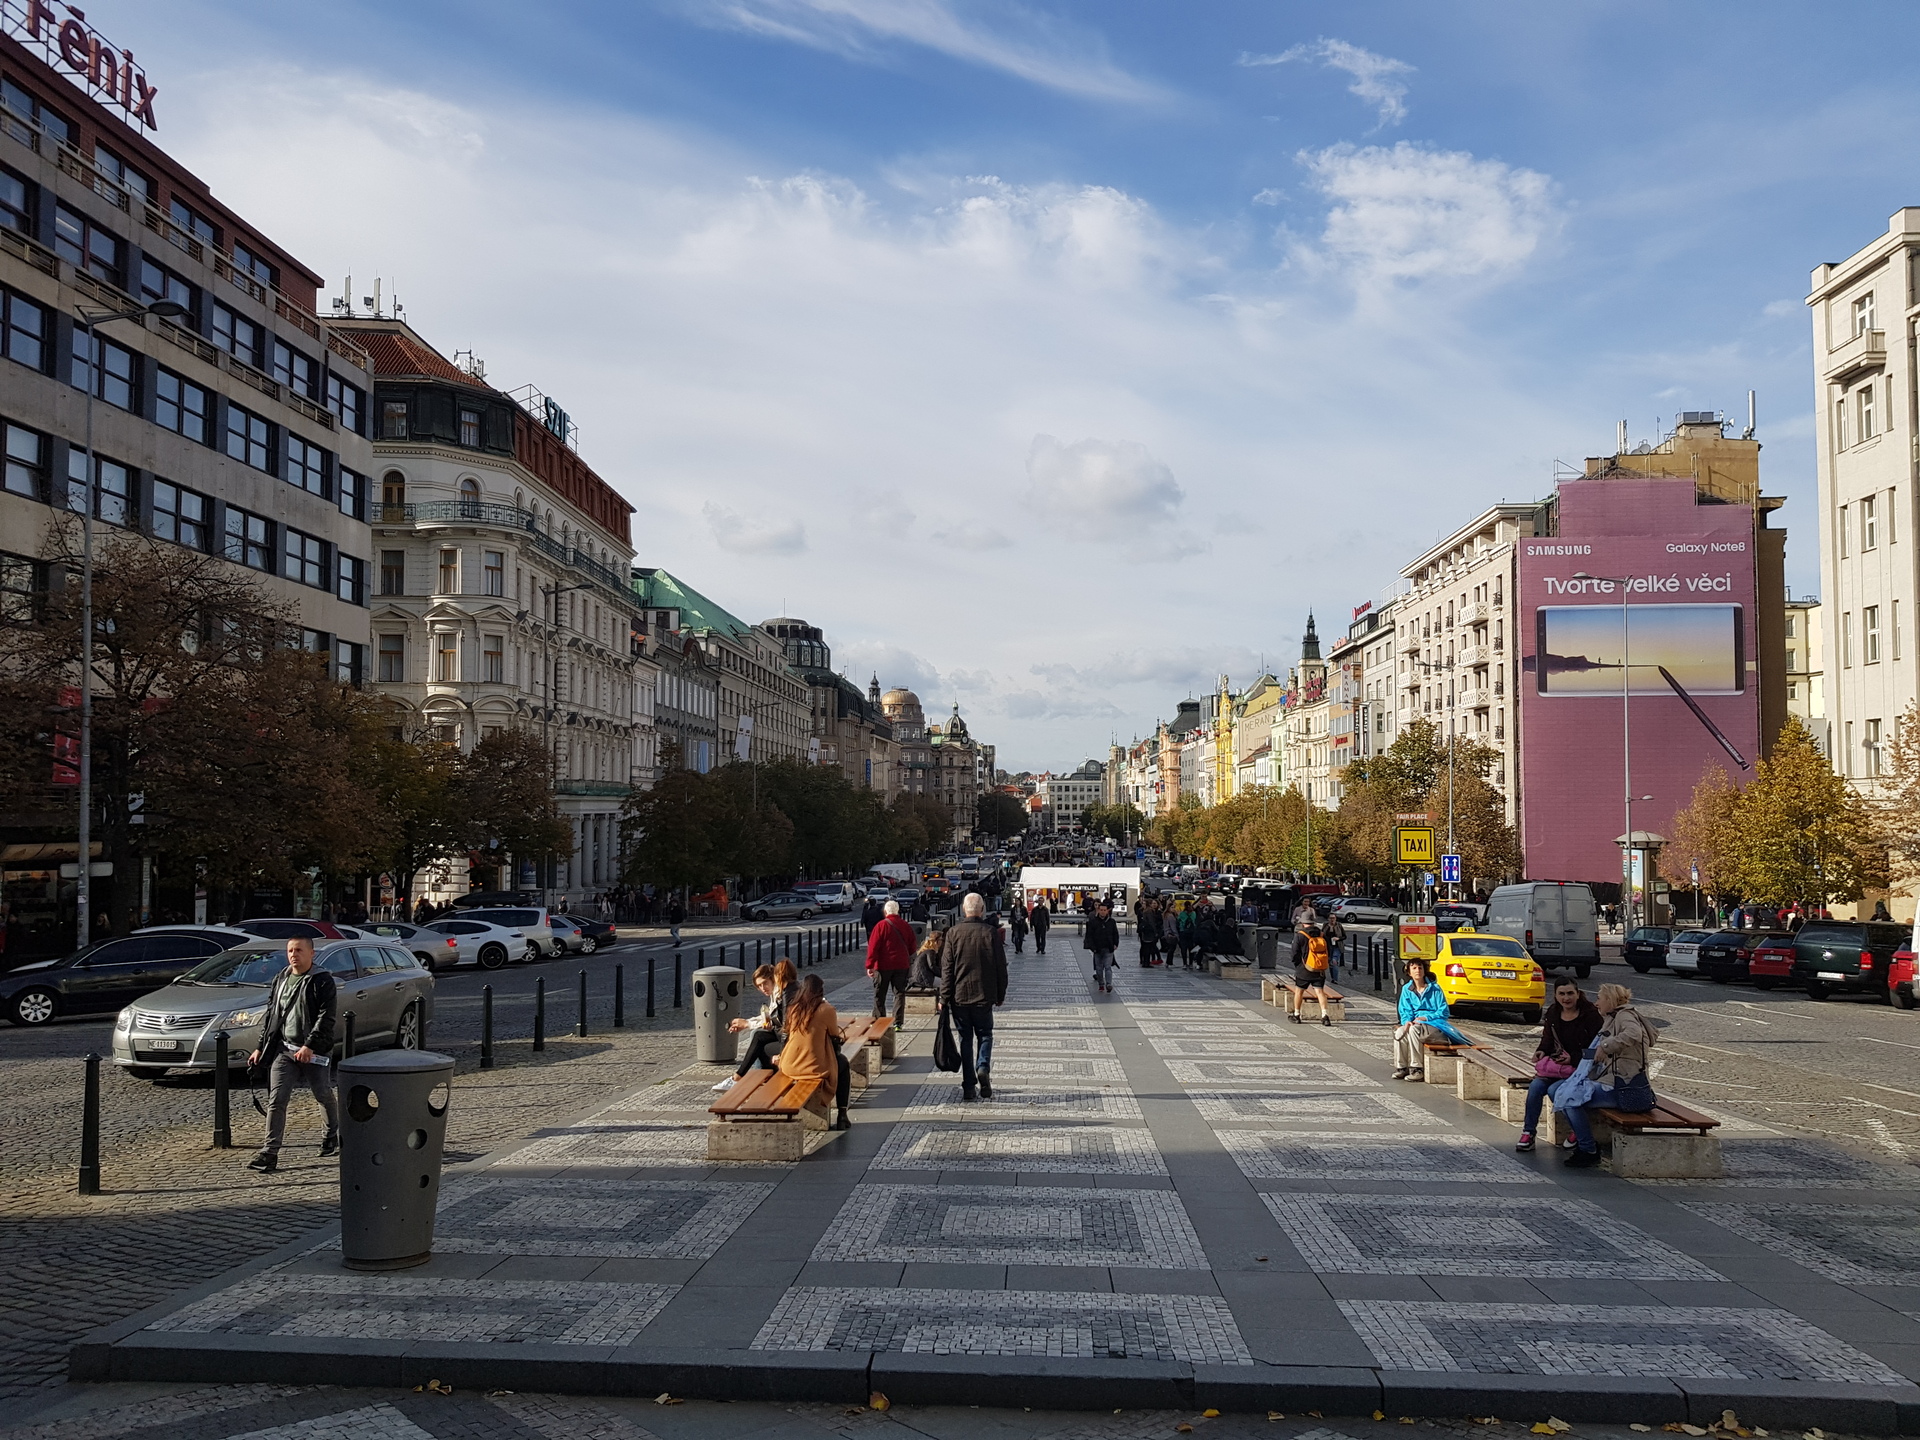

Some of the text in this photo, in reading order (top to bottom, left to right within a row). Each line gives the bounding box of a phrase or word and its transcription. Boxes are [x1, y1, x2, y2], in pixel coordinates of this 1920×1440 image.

[544, 396, 571, 445] SZIF
[1527, 544, 1592, 556] SAMSUNG
[1666, 541, 1746, 555] Galaxy Note8
[1622, 573, 1681, 593] velké
[1685, 572, 1732, 592] věci
[1245, 714, 1270, 731] MERAN
[1403, 838, 1427, 852] TAXI
[1137, 849, 1143, 857] P
[1426, 874, 1432, 882] P
